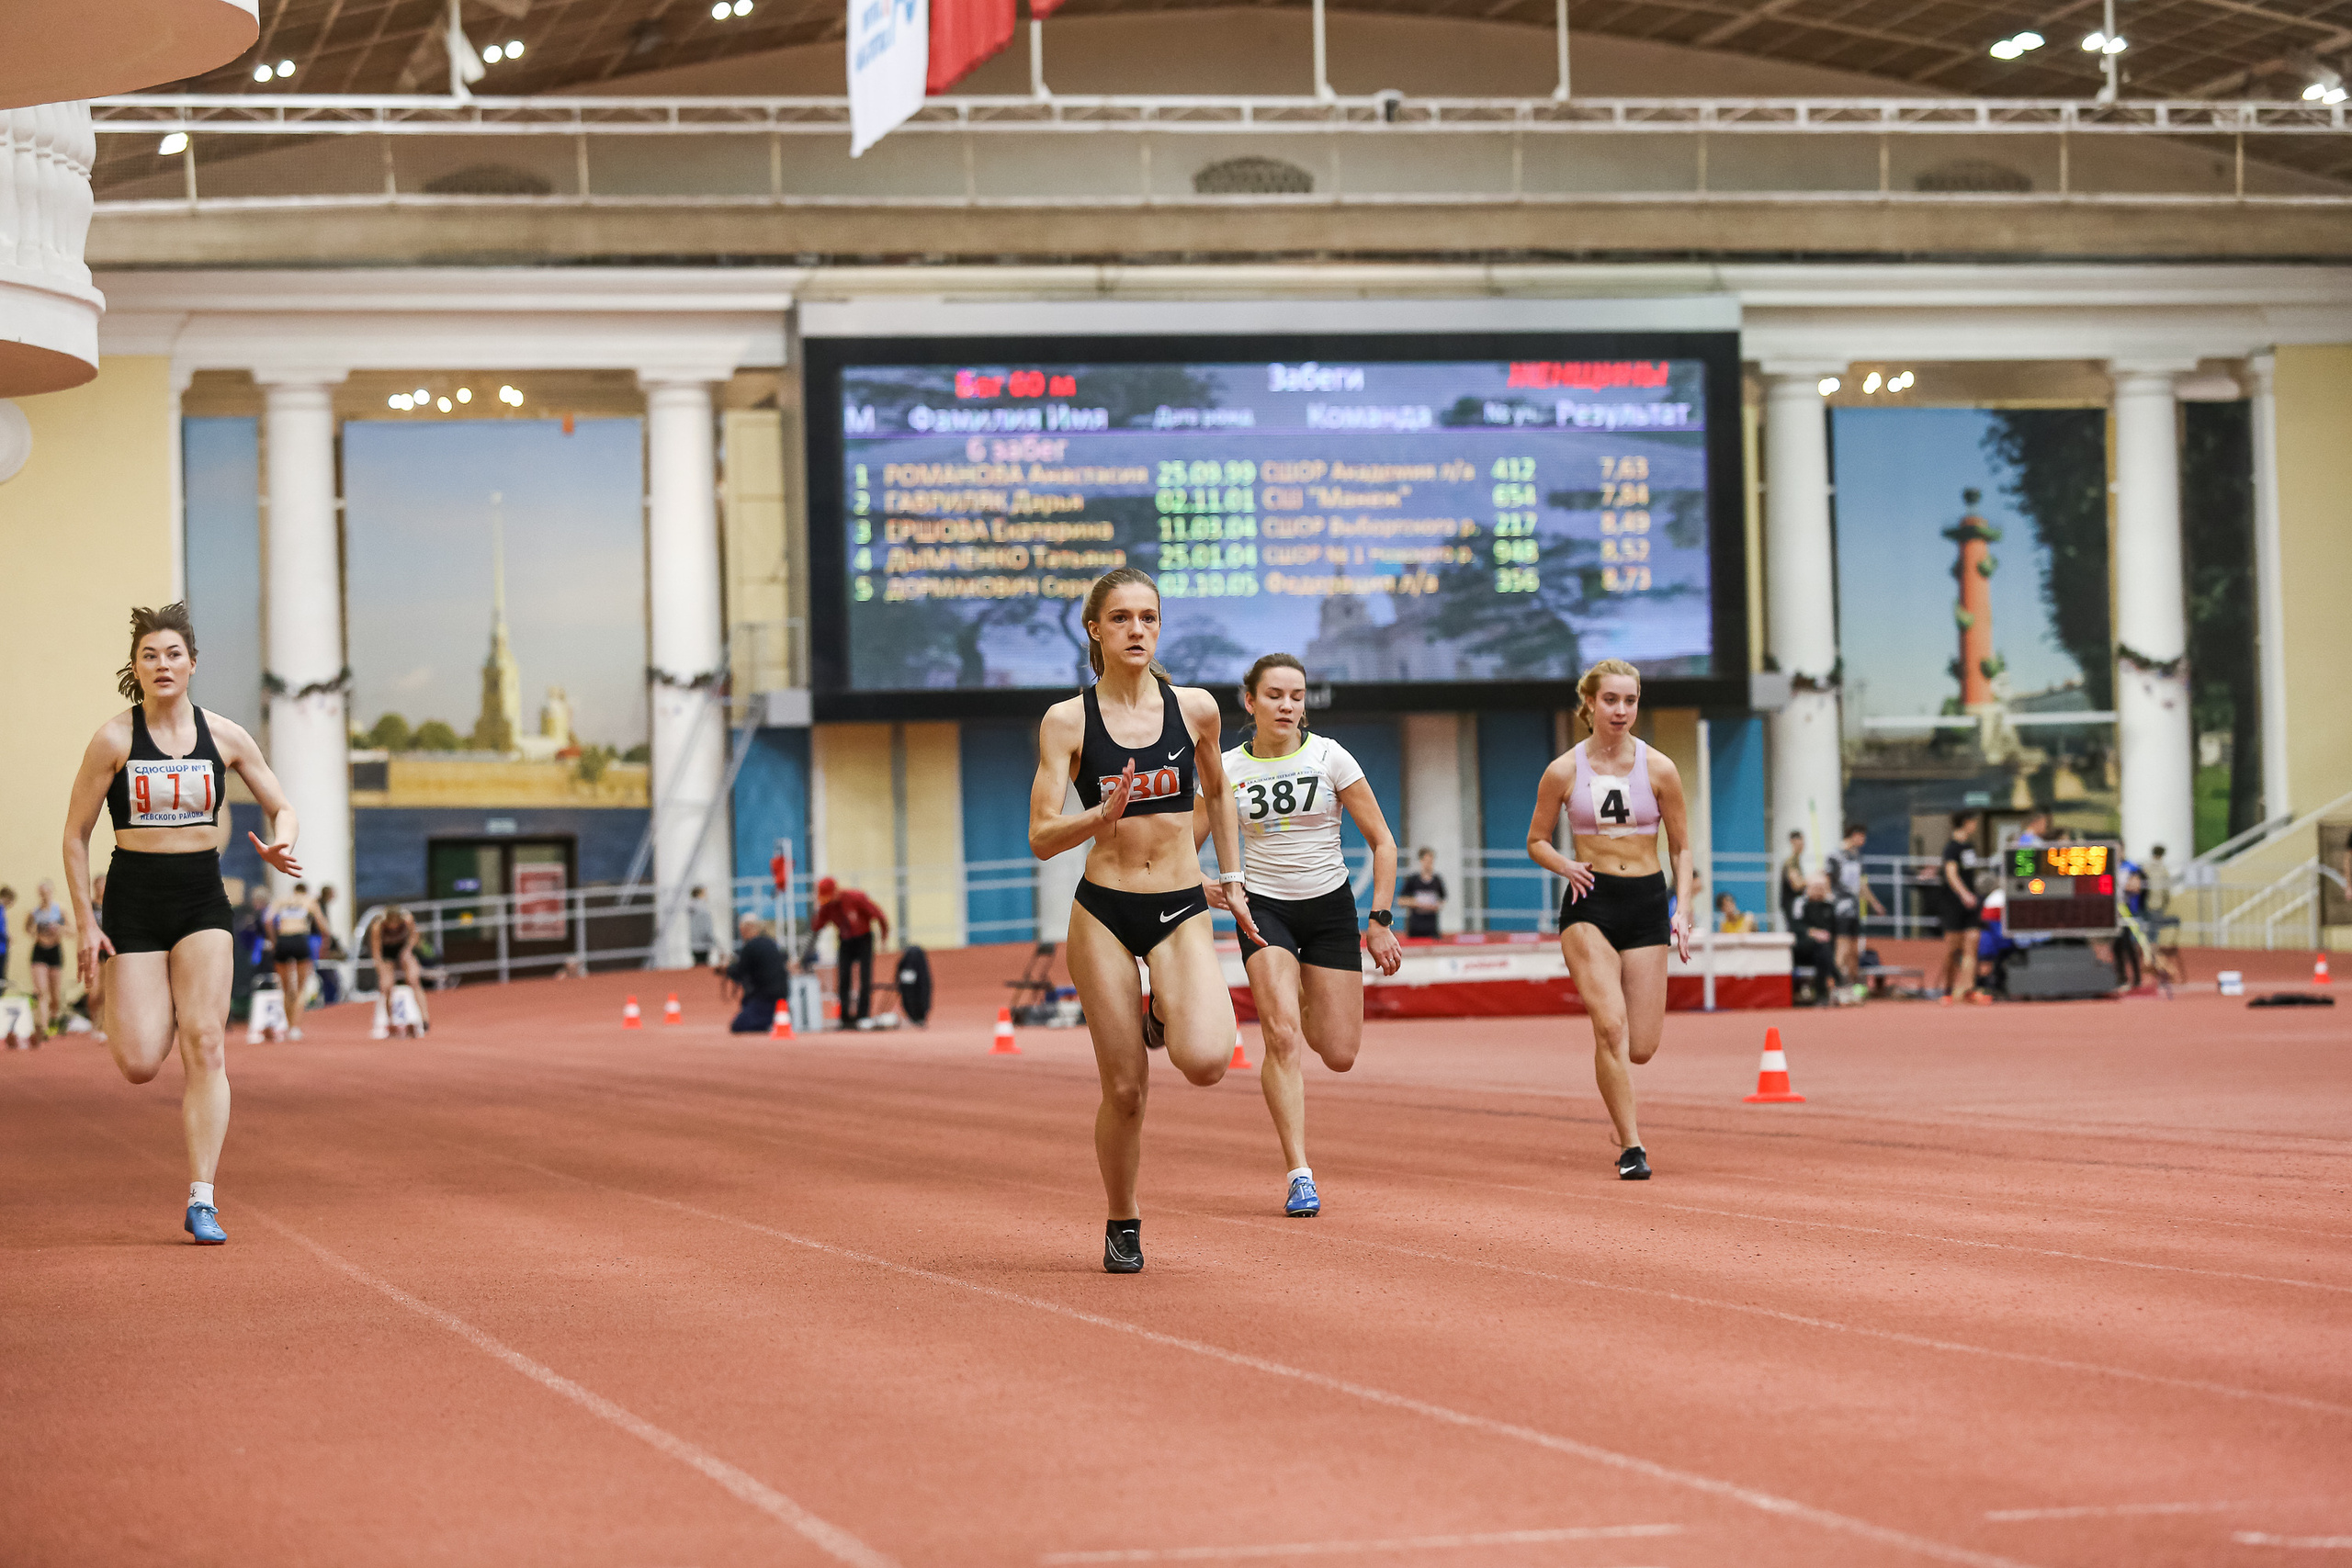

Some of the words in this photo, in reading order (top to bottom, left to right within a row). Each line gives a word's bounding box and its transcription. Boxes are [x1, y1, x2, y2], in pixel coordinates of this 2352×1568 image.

[1007, 368, 1046, 398] 60
[1266, 364, 1365, 391] Забеги
[843, 405, 874, 432] М
[908, 404, 1042, 433] Фамилия
[1046, 402, 1108, 433] Имя
[1306, 403, 1431, 430] Команда
[1556, 400, 1692, 429] Результат
[989, 436, 1069, 463] забег
[884, 463, 1023, 488] РОМАНОВА
[1025, 463, 1148, 486] Анастасия
[1261, 460, 1328, 483] СШОР
[1491, 457, 1536, 481] 412
[1597, 457, 1649, 481] 7,63
[1009, 490, 1085, 517] Дарья
[885, 518, 989, 543] ЕРШОВА
[990, 518, 1114, 546] Екатерина
[1261, 517, 1325, 538] СШОР
[1491, 512, 1538, 534] 217
[1030, 547, 1127, 570] Татьяна
[134, 764, 189, 774] СДЮСШОР
[1247, 776, 1319, 819] 387
[1600, 789, 1630, 824] 4
[2015, 849, 2035, 876] 5
